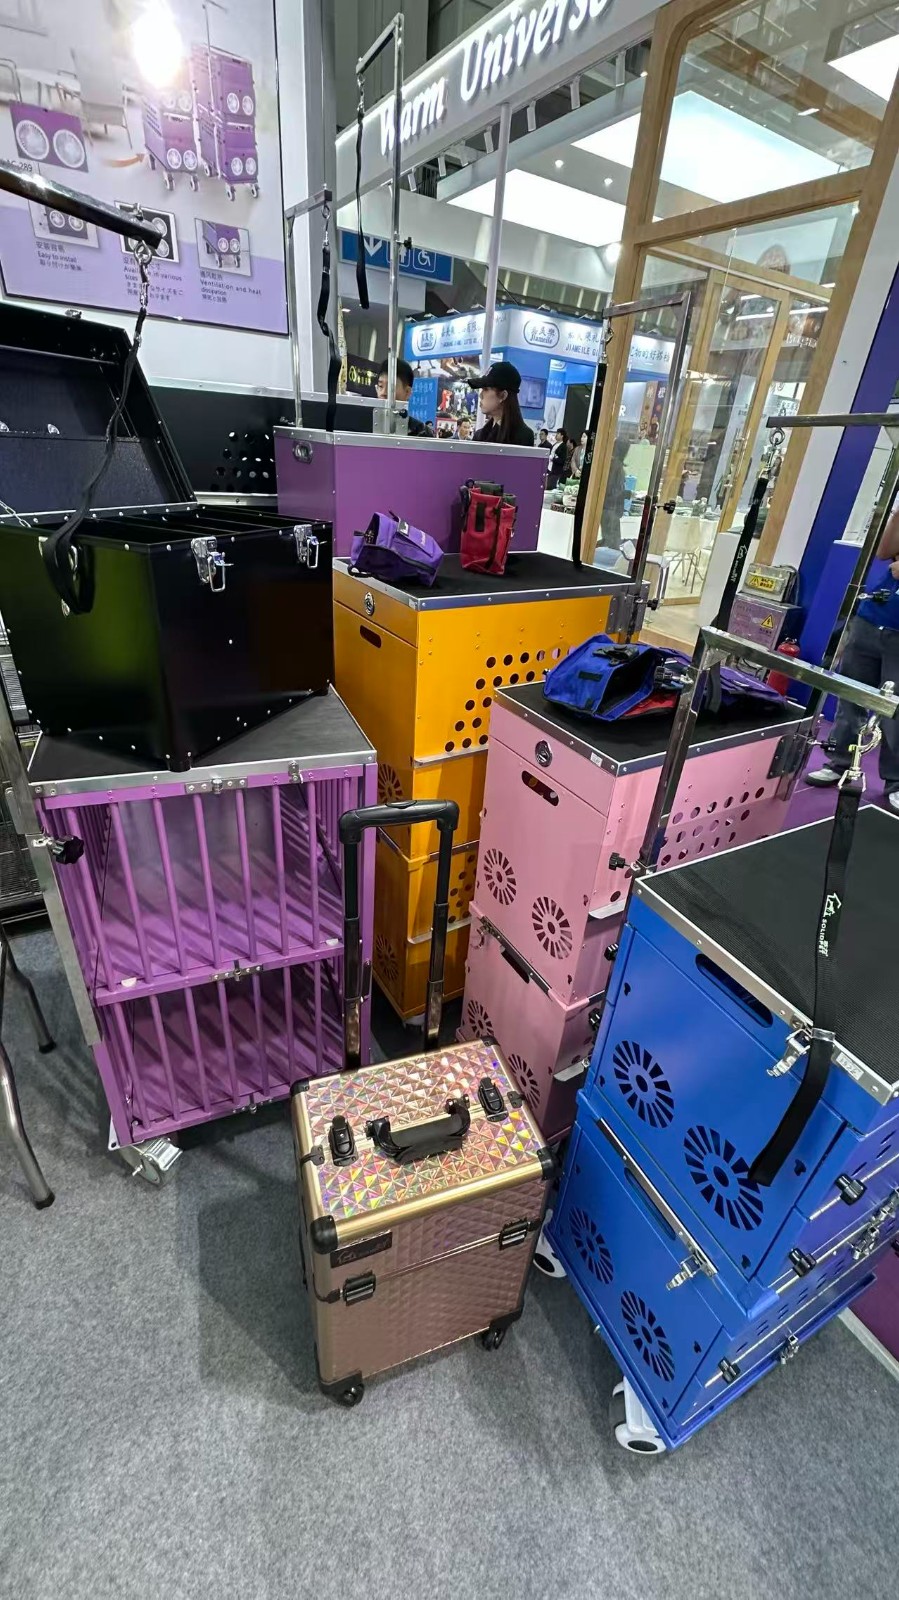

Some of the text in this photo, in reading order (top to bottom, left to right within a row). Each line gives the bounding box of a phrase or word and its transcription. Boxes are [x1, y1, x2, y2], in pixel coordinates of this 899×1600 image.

[380, 77, 447, 155] Warm
[37, 251, 77, 263] Easy to install
[161, 273, 183, 282] various
[200, 280, 262, 296] Ventilation and heat
